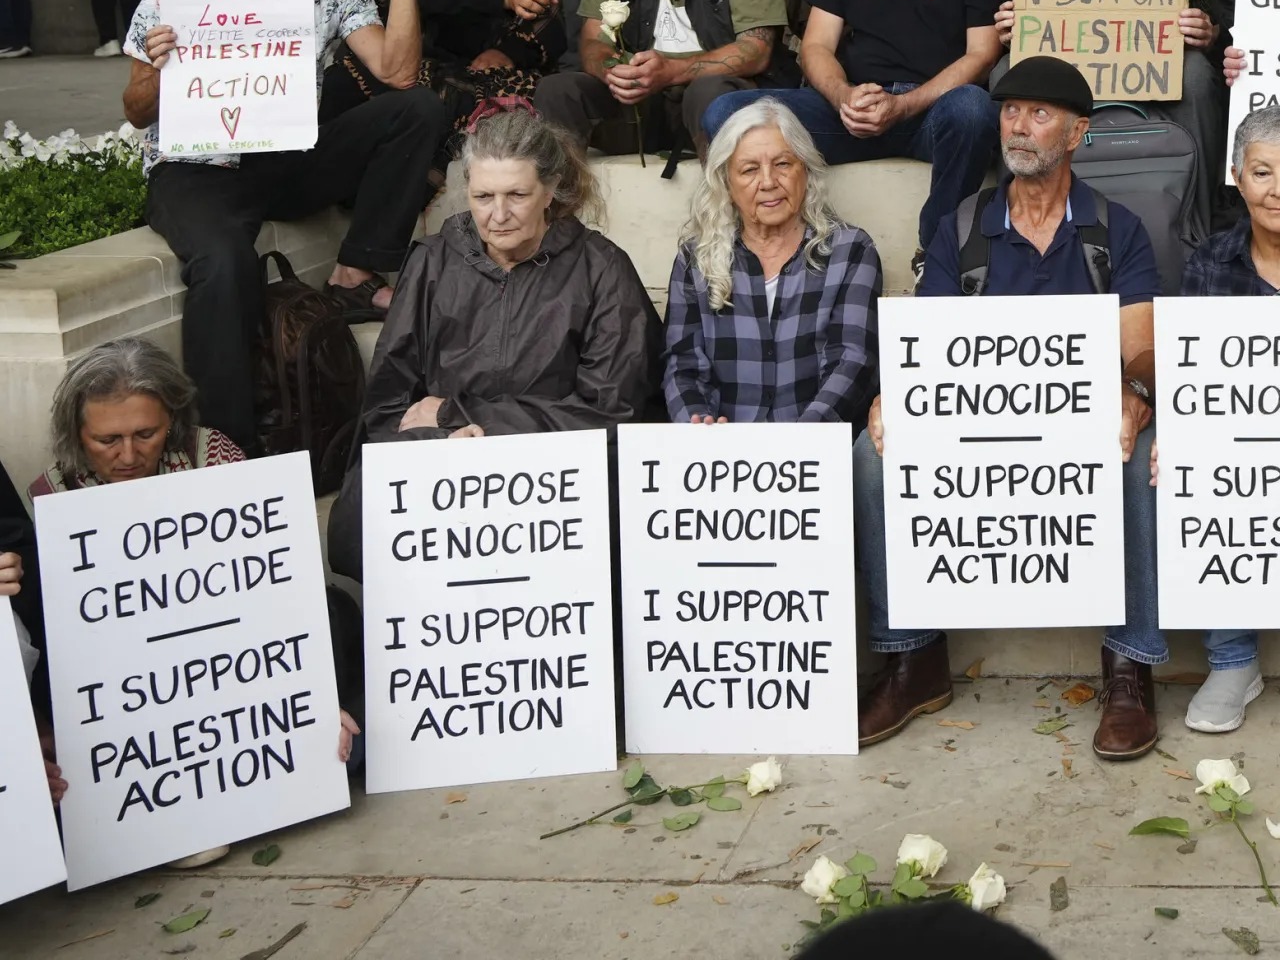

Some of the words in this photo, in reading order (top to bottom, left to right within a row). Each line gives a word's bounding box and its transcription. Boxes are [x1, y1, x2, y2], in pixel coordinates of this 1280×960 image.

[1018, 15, 1176, 55] PALESTINE
[1072, 61, 1169, 95] TION
[1248, 49, 1265, 76] I
[900, 337, 920, 368] I
[947, 334, 1086, 367] OPPOSE
[1178, 337, 1200, 367] I
[905, 381, 1091, 416] GENOCIDE
[389, 480, 407, 514] I
[433, 469, 580, 511] OPPOSE
[642, 461, 660, 492] I
[684, 460, 819, 493] OPPOSE
[900, 465, 918, 499] I
[934, 463, 1103, 499] SUPPORT
[1175, 466, 1194, 497] I
[69, 529, 97, 572] I
[123, 496, 288, 560] OPPOSE
[392, 518, 583, 561] GENOCIDE
[647, 509, 820, 541] GENOCIDE
[912, 514, 1096, 548] PALESTINE
[80, 547, 292, 623] GENOCIDE
[927, 553, 1068, 584] ACTION
[644, 590, 660, 621] I
[676, 590, 829, 622] SUPPORT
[385, 617, 406, 650] I
[421, 602, 594, 646] SUPPORT
[647, 641, 832, 673] PALESTINE
[77, 683, 104, 725] I
[122, 633, 309, 712] SUPPORT
[390, 654, 588, 703] PALESTINE
[663, 678, 810, 710] ACTION
[411, 697, 562, 741] ACTION
[91, 691, 315, 783] PALESTINE
[117, 739, 294, 822] ACTION
